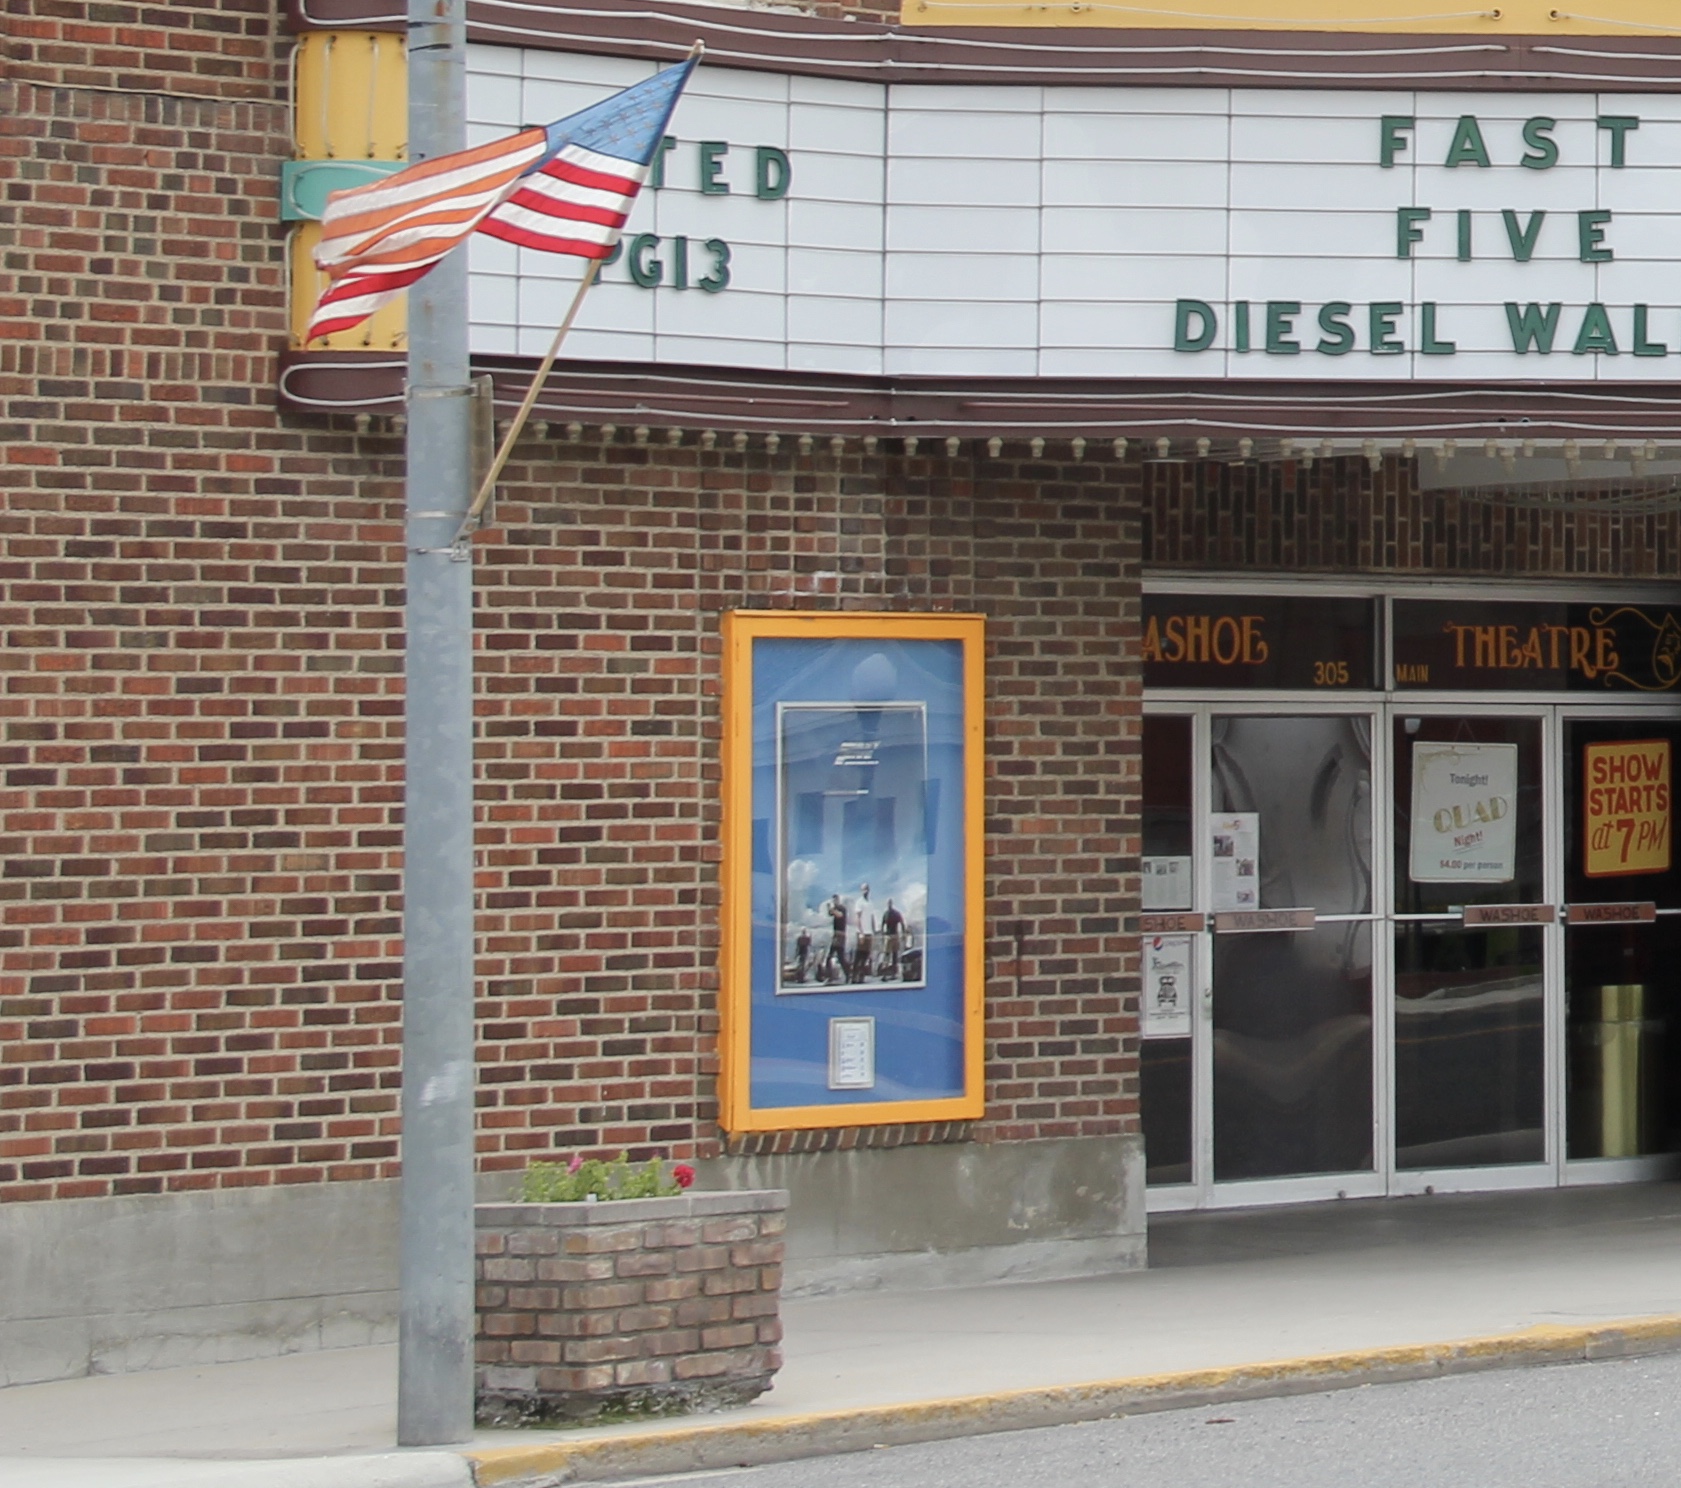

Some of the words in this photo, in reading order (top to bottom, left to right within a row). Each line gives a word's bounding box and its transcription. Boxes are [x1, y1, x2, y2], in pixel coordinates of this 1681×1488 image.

[1380, 115, 1640, 170] FAST
[1397, 206, 1614, 264] FIVE
[1174, 299, 1456, 355] DIESEL
[1443, 620, 1620, 679] THEATRE
[1314, 661, 1349, 685] 305
[1396, 664, 1429, 683] MAIN
[1450, 773, 1489, 787] Tonight!
[1593, 753, 1664, 785] SHOW
[1433, 796, 1508, 833] QUAD
[1590, 783, 1668, 817] STARTS
[1454, 831, 1483, 847] Night!
[1591, 820, 1614, 852] at
[1616, 818, 1635, 863] 7
[1637, 816, 1667, 851] PM
[1463, 861, 1475, 870] per
[1477, 861, 1503, 870] person
[1234, 912, 1298, 929] WASHOE
[1479, 907, 1539, 922] WASHOE
[1584, 906, 1641, 921] WASHOE
